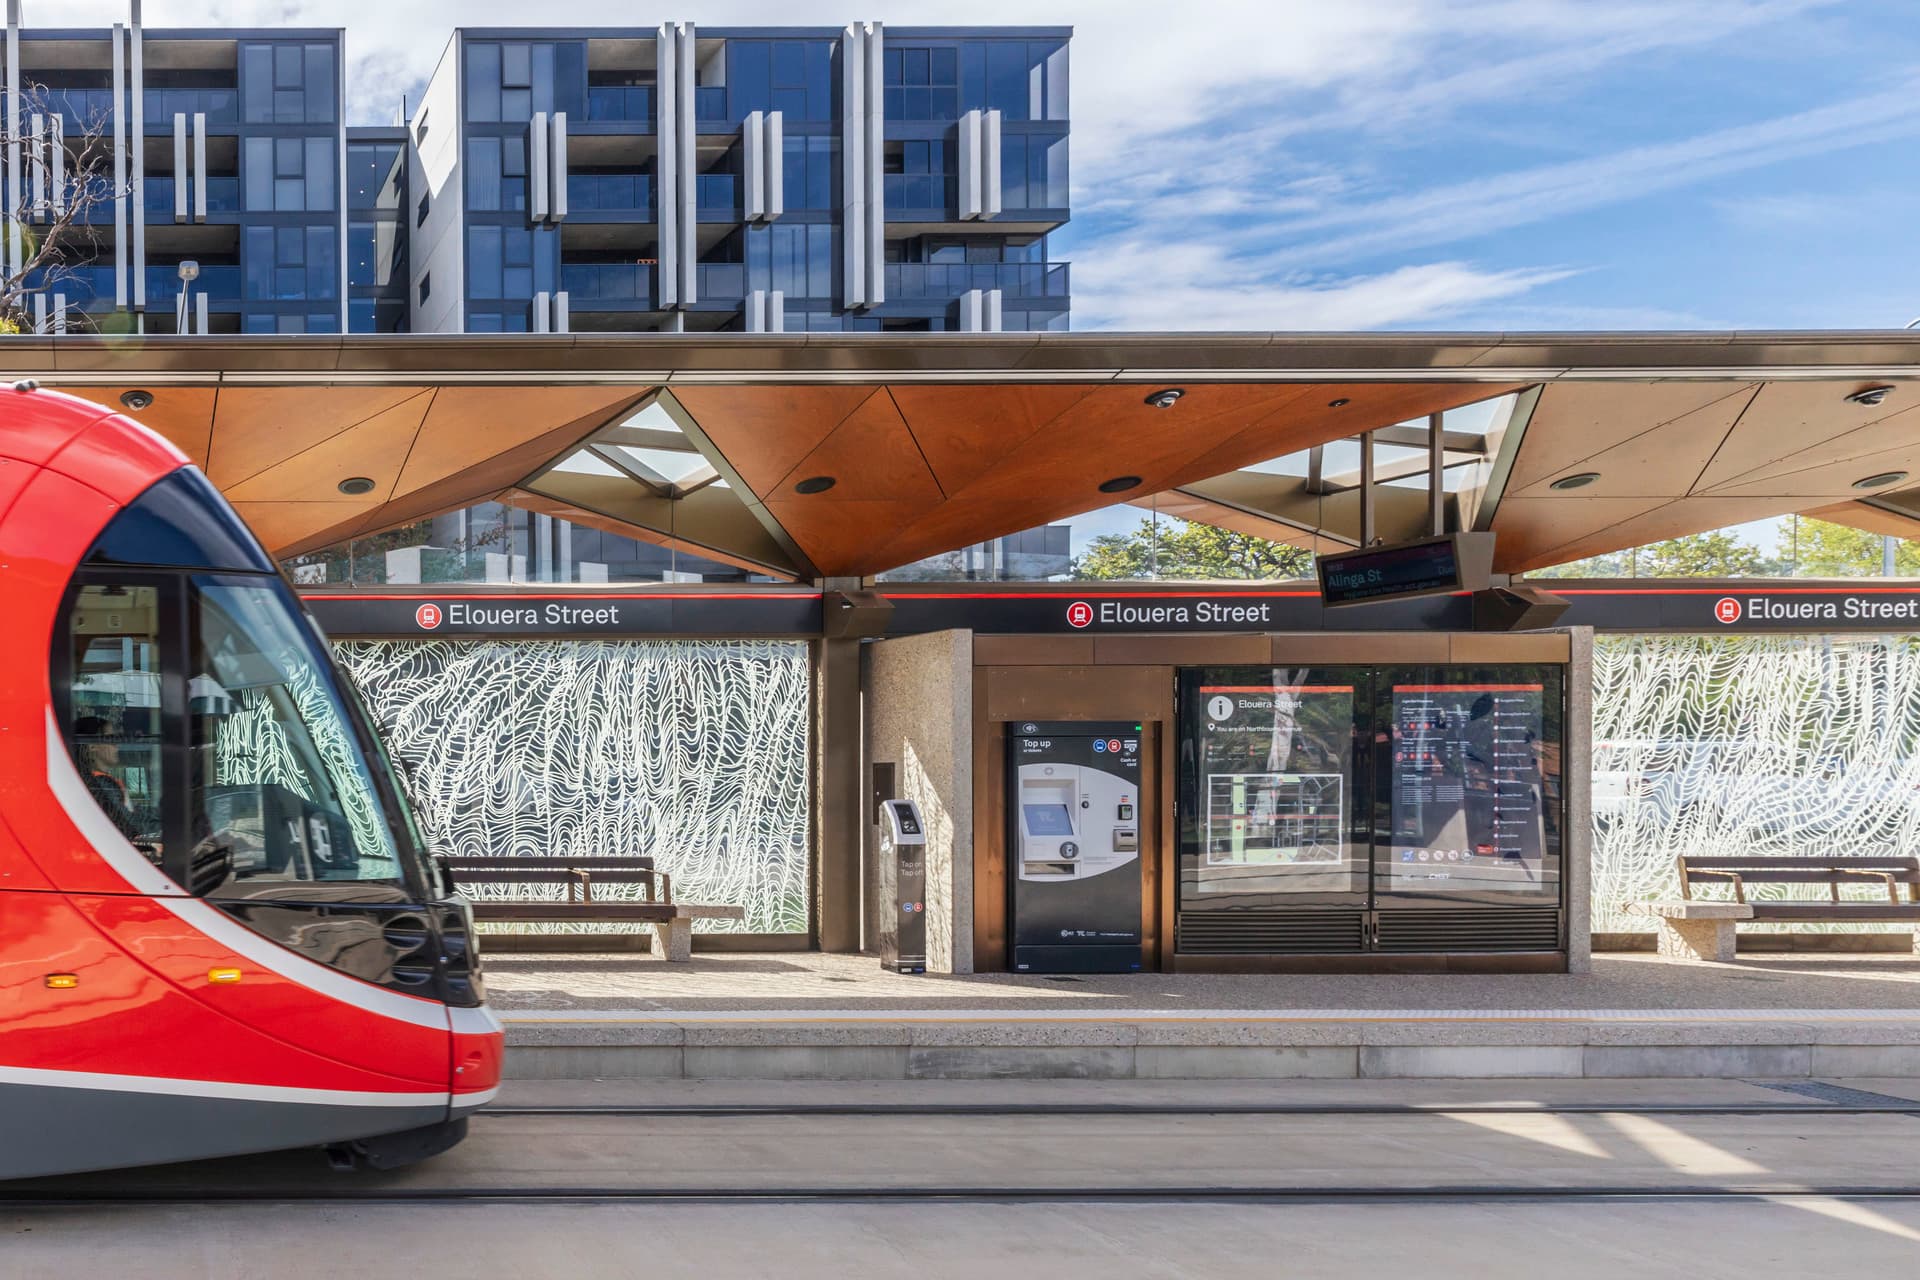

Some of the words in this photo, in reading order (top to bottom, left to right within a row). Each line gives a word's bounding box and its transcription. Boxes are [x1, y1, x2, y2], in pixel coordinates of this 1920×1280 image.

[1328, 573, 1366, 588] Alinga
[1367, 569, 1383, 582] St
[449, 604, 538, 625] Elouera
[544, 603, 620, 625] Street
[1100, 602, 1189, 623] Elouera
[1195, 601, 1270, 623] Street
[1748, 598, 1837, 619] Elouera
[1843, 597, 1918, 618] Street
[1238, 699, 1273, 709] Elouera
[1274, 699, 1303, 709] Street
[1023, 739, 1039, 749] Top
[1040, 740, 1051, 749] up
[901, 861, 913, 869] Tap
[901, 869, 913, 877] Tap
